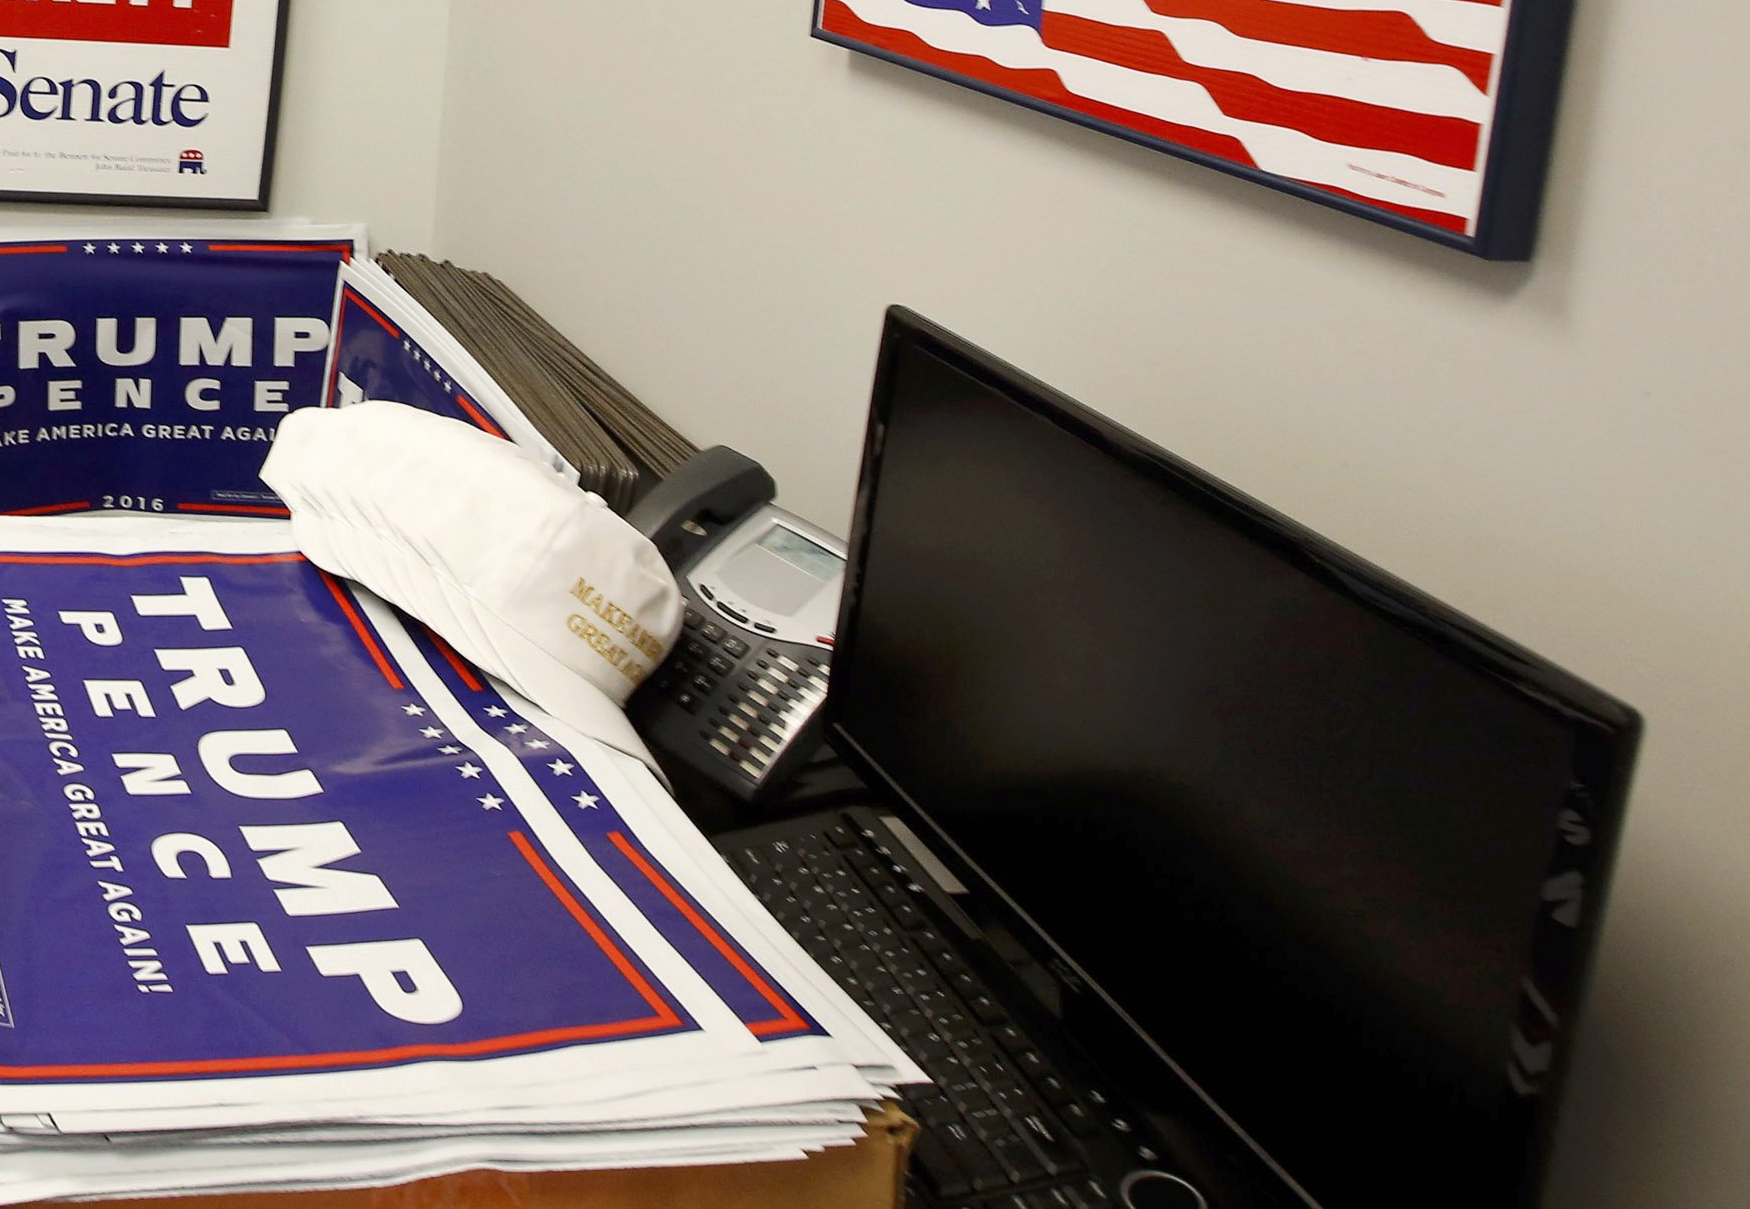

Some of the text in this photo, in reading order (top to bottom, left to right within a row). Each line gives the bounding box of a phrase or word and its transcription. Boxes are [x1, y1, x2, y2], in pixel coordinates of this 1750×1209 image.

[36, 422, 135, 442] AMERICA
[141, 424, 215, 441] GREAT
[220, 426, 276, 441] AGAI
[101, 494, 165, 512] 2016
[569, 576, 632, 633] MAKE
[1, 598, 174, 994] MAKE AMERICA GREAT AGAIN!
[58, 610, 281, 975] PENCE
[130, 576, 463, 1024] TRUMP
